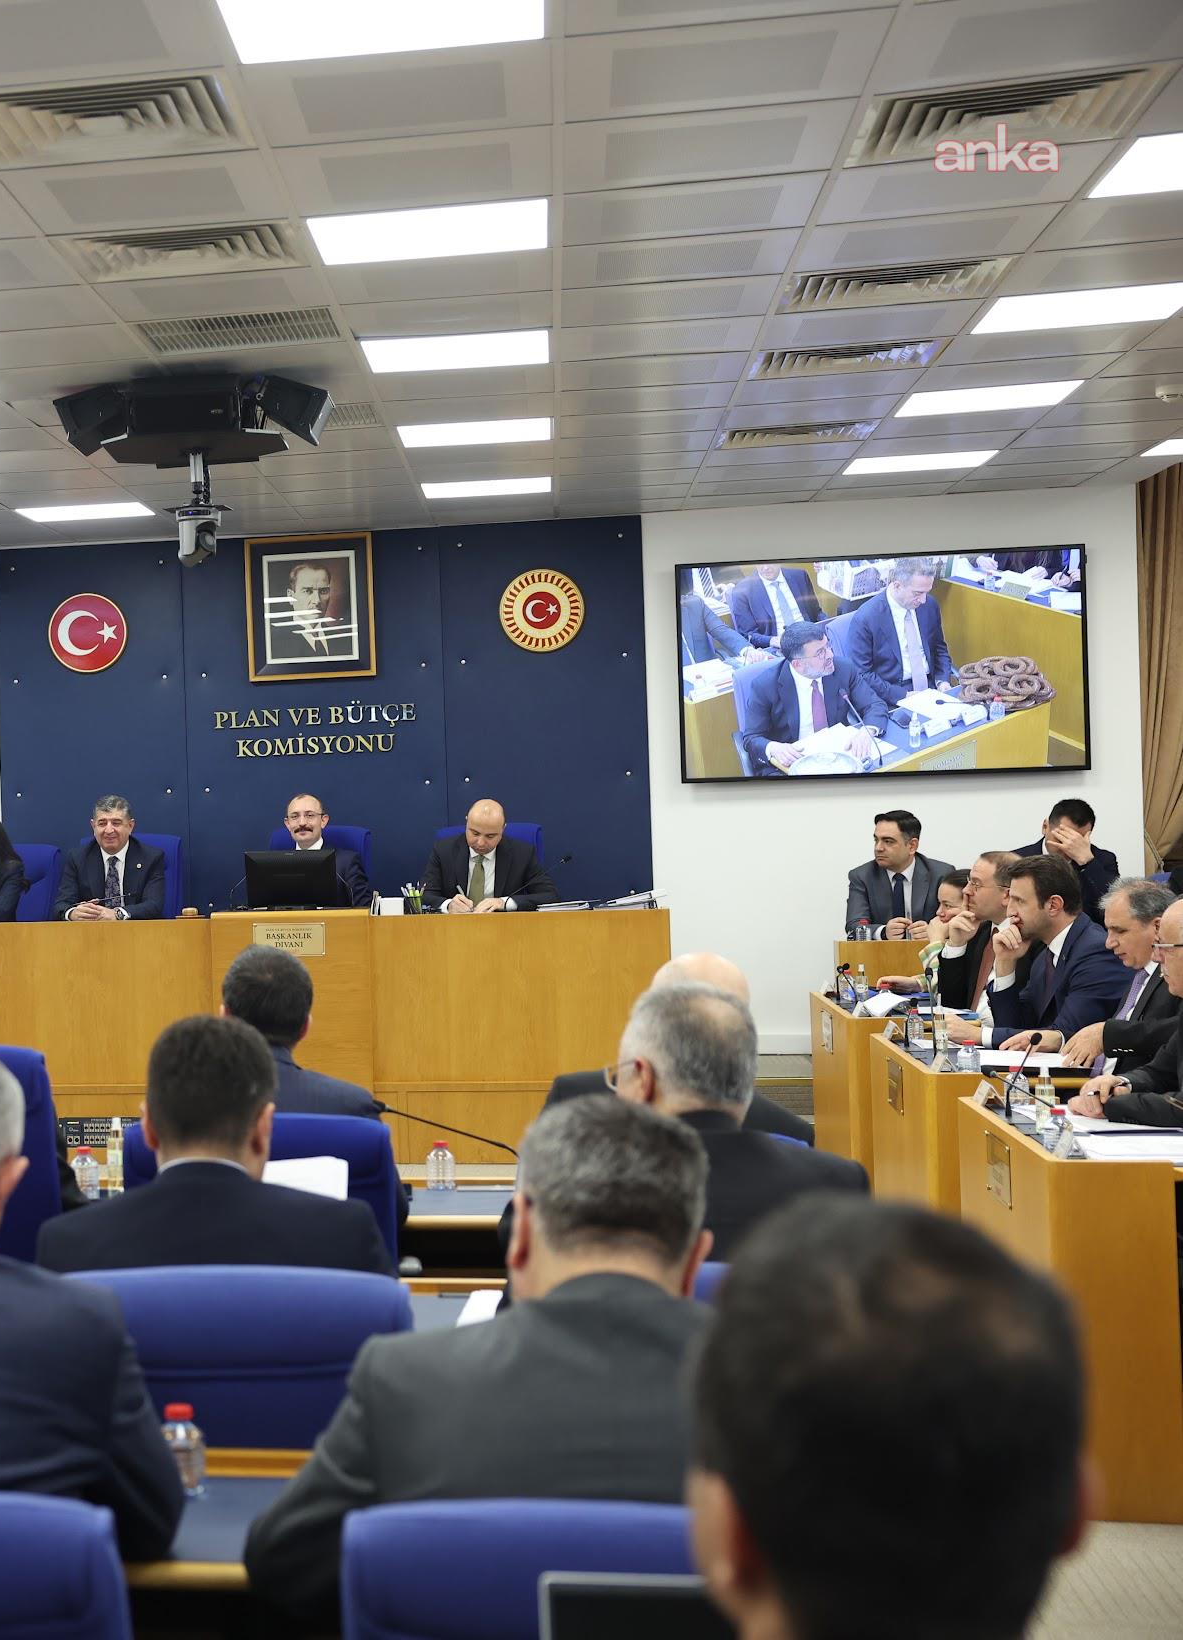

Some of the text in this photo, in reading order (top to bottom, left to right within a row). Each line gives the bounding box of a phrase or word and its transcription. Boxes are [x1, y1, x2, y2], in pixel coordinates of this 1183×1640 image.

[214, 700, 417, 730] PLAN VE BÜTÇE
[236, 731, 396, 758] KOMİSYONU
